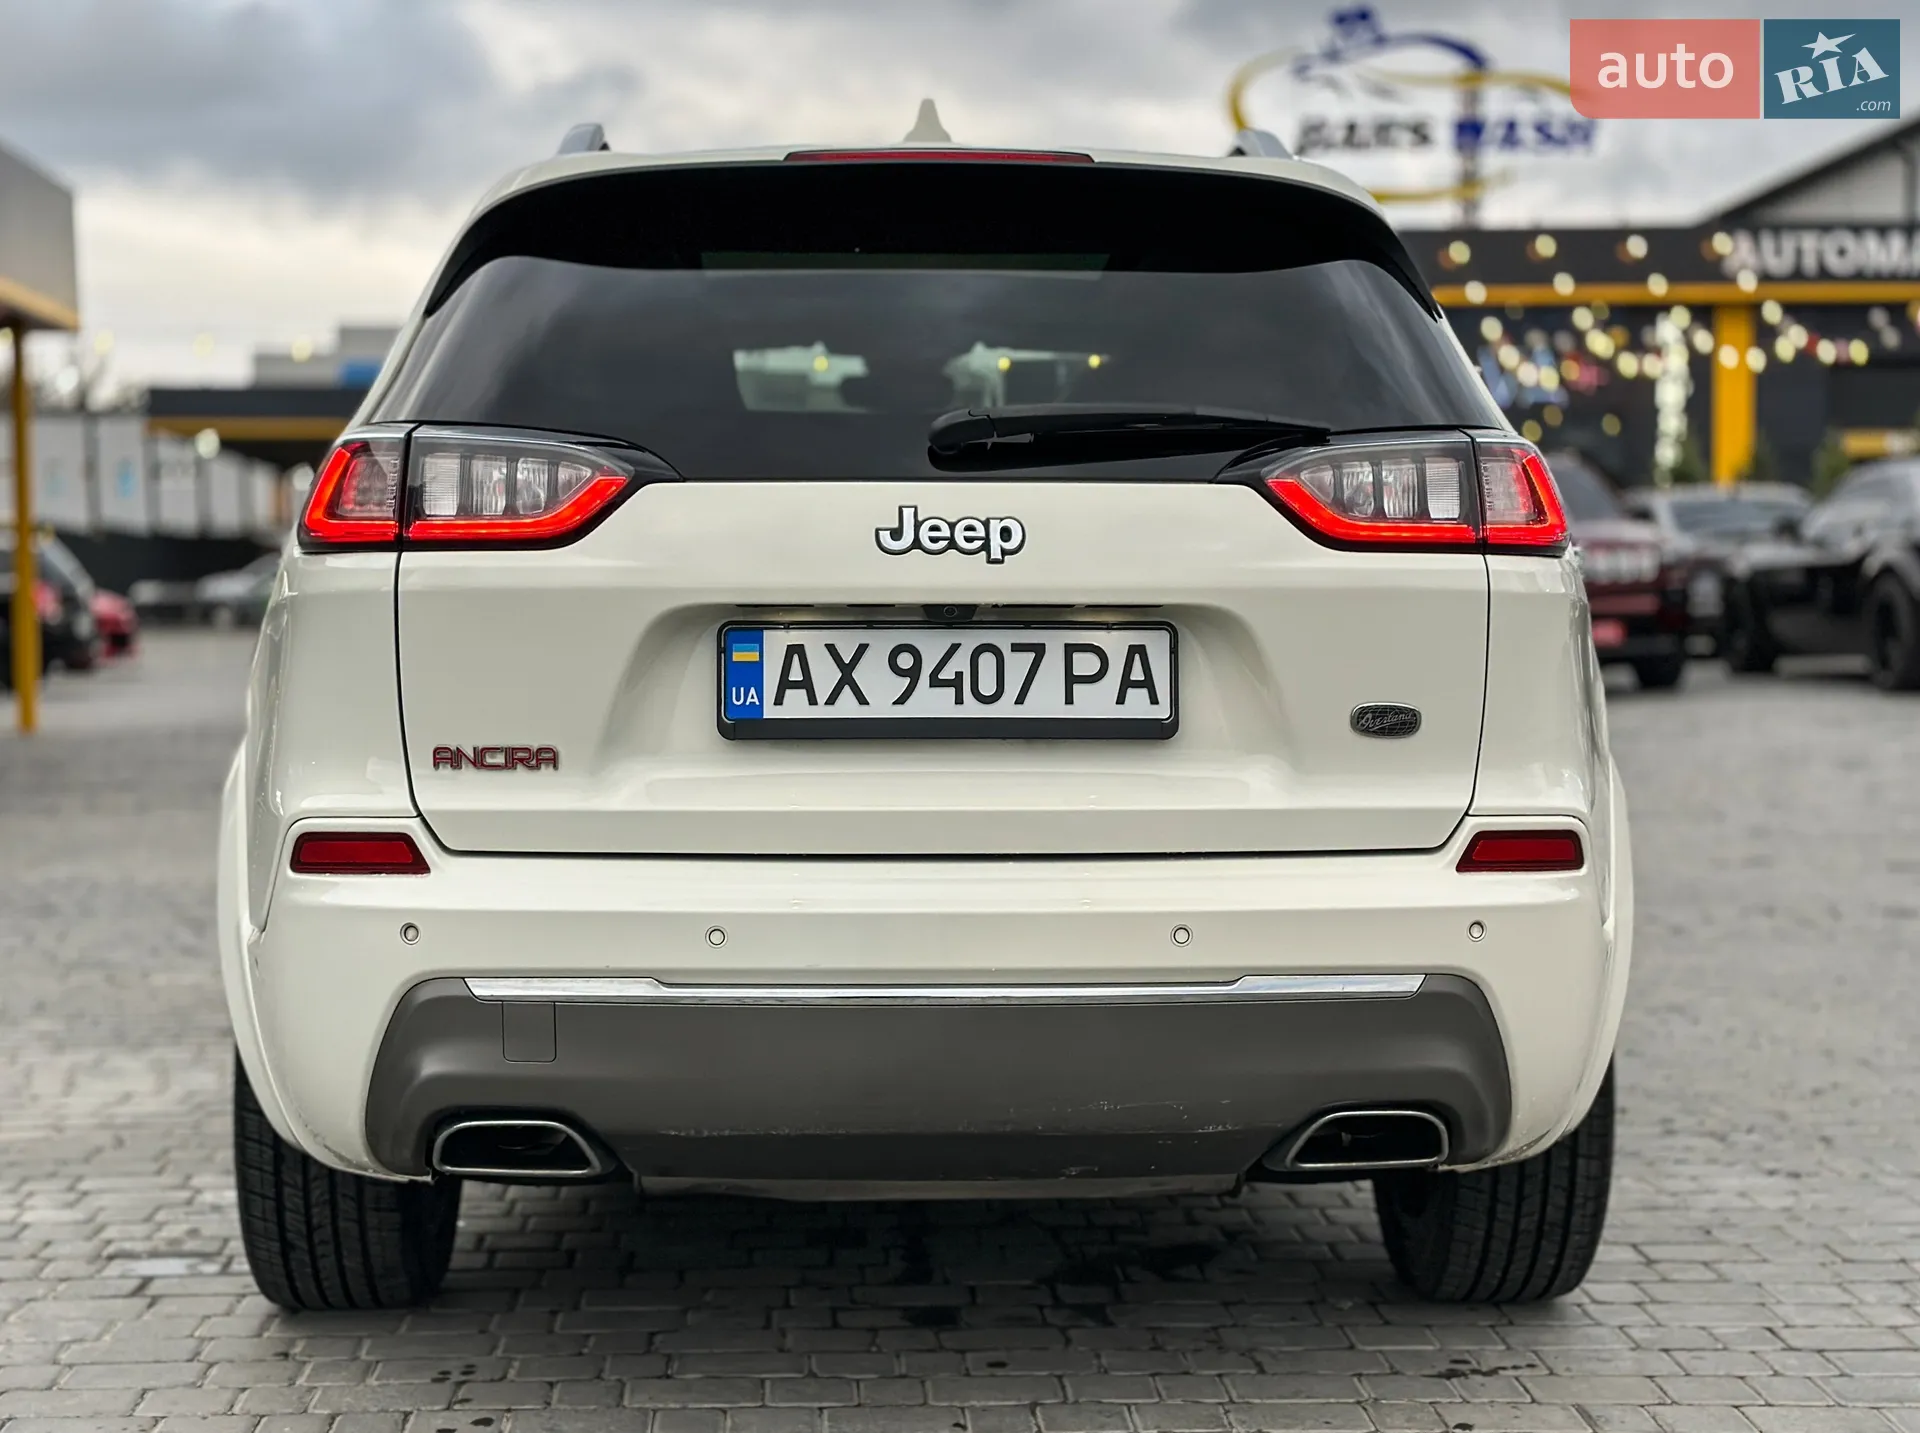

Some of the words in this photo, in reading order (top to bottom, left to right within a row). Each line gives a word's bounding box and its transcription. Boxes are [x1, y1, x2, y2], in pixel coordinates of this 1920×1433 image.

[1722, 228, 1920, 279] AUTOM
[875, 505, 1026, 564] Jeep
[773, 643, 870, 707] AX
[887, 643, 1047, 707] 9407
[1064, 643, 1160, 707] PA
[731, 688, 761, 706] UA
[1358, 709, 1415, 731] Overland
[432, 744, 559, 771] ANCIRA
